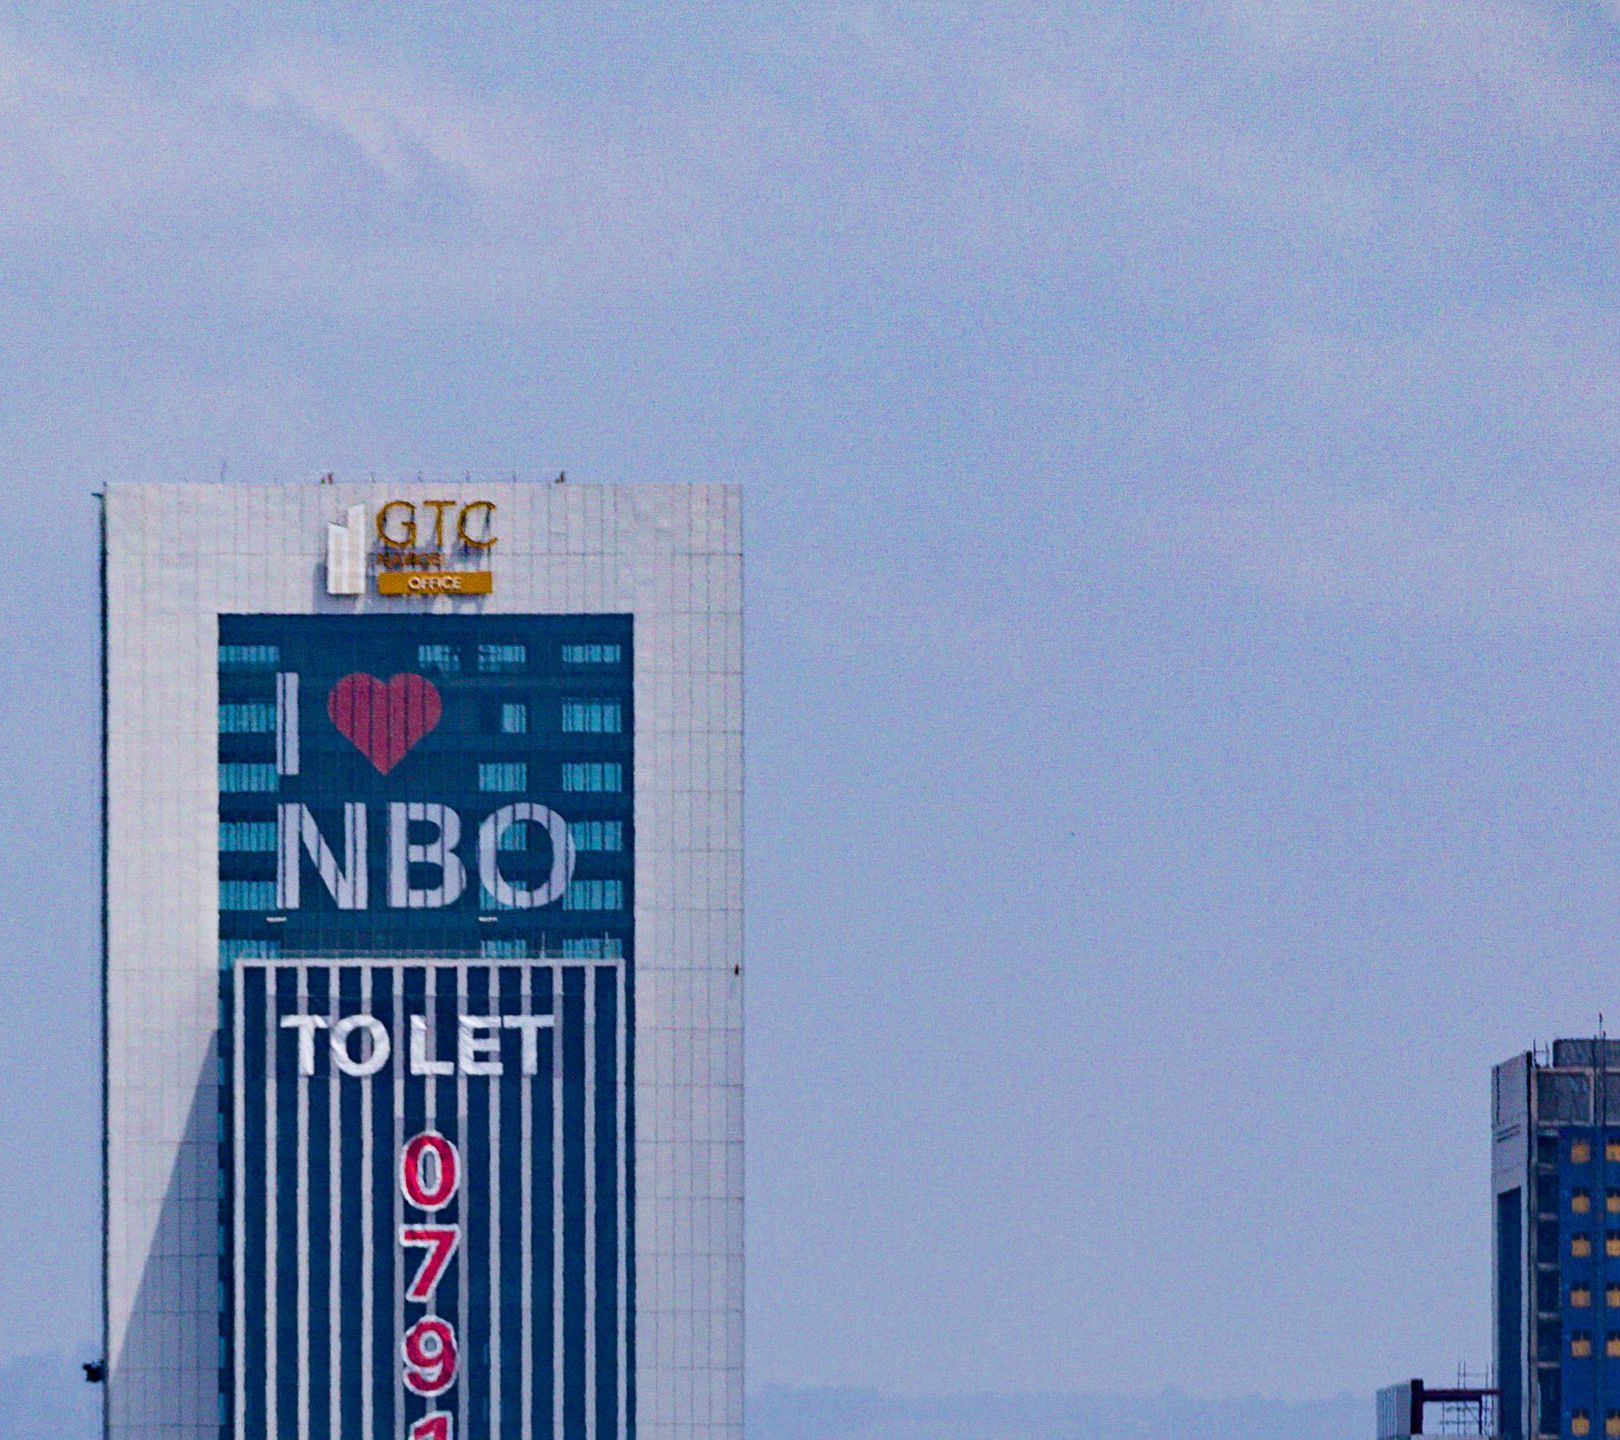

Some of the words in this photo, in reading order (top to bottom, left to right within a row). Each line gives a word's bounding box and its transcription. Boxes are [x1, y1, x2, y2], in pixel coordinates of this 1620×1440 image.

[376, 500, 498, 549] GTC
[408, 575, 462, 590] OFFICE
[276, 672, 299, 775] I
[276, 801, 576, 910] NBO
